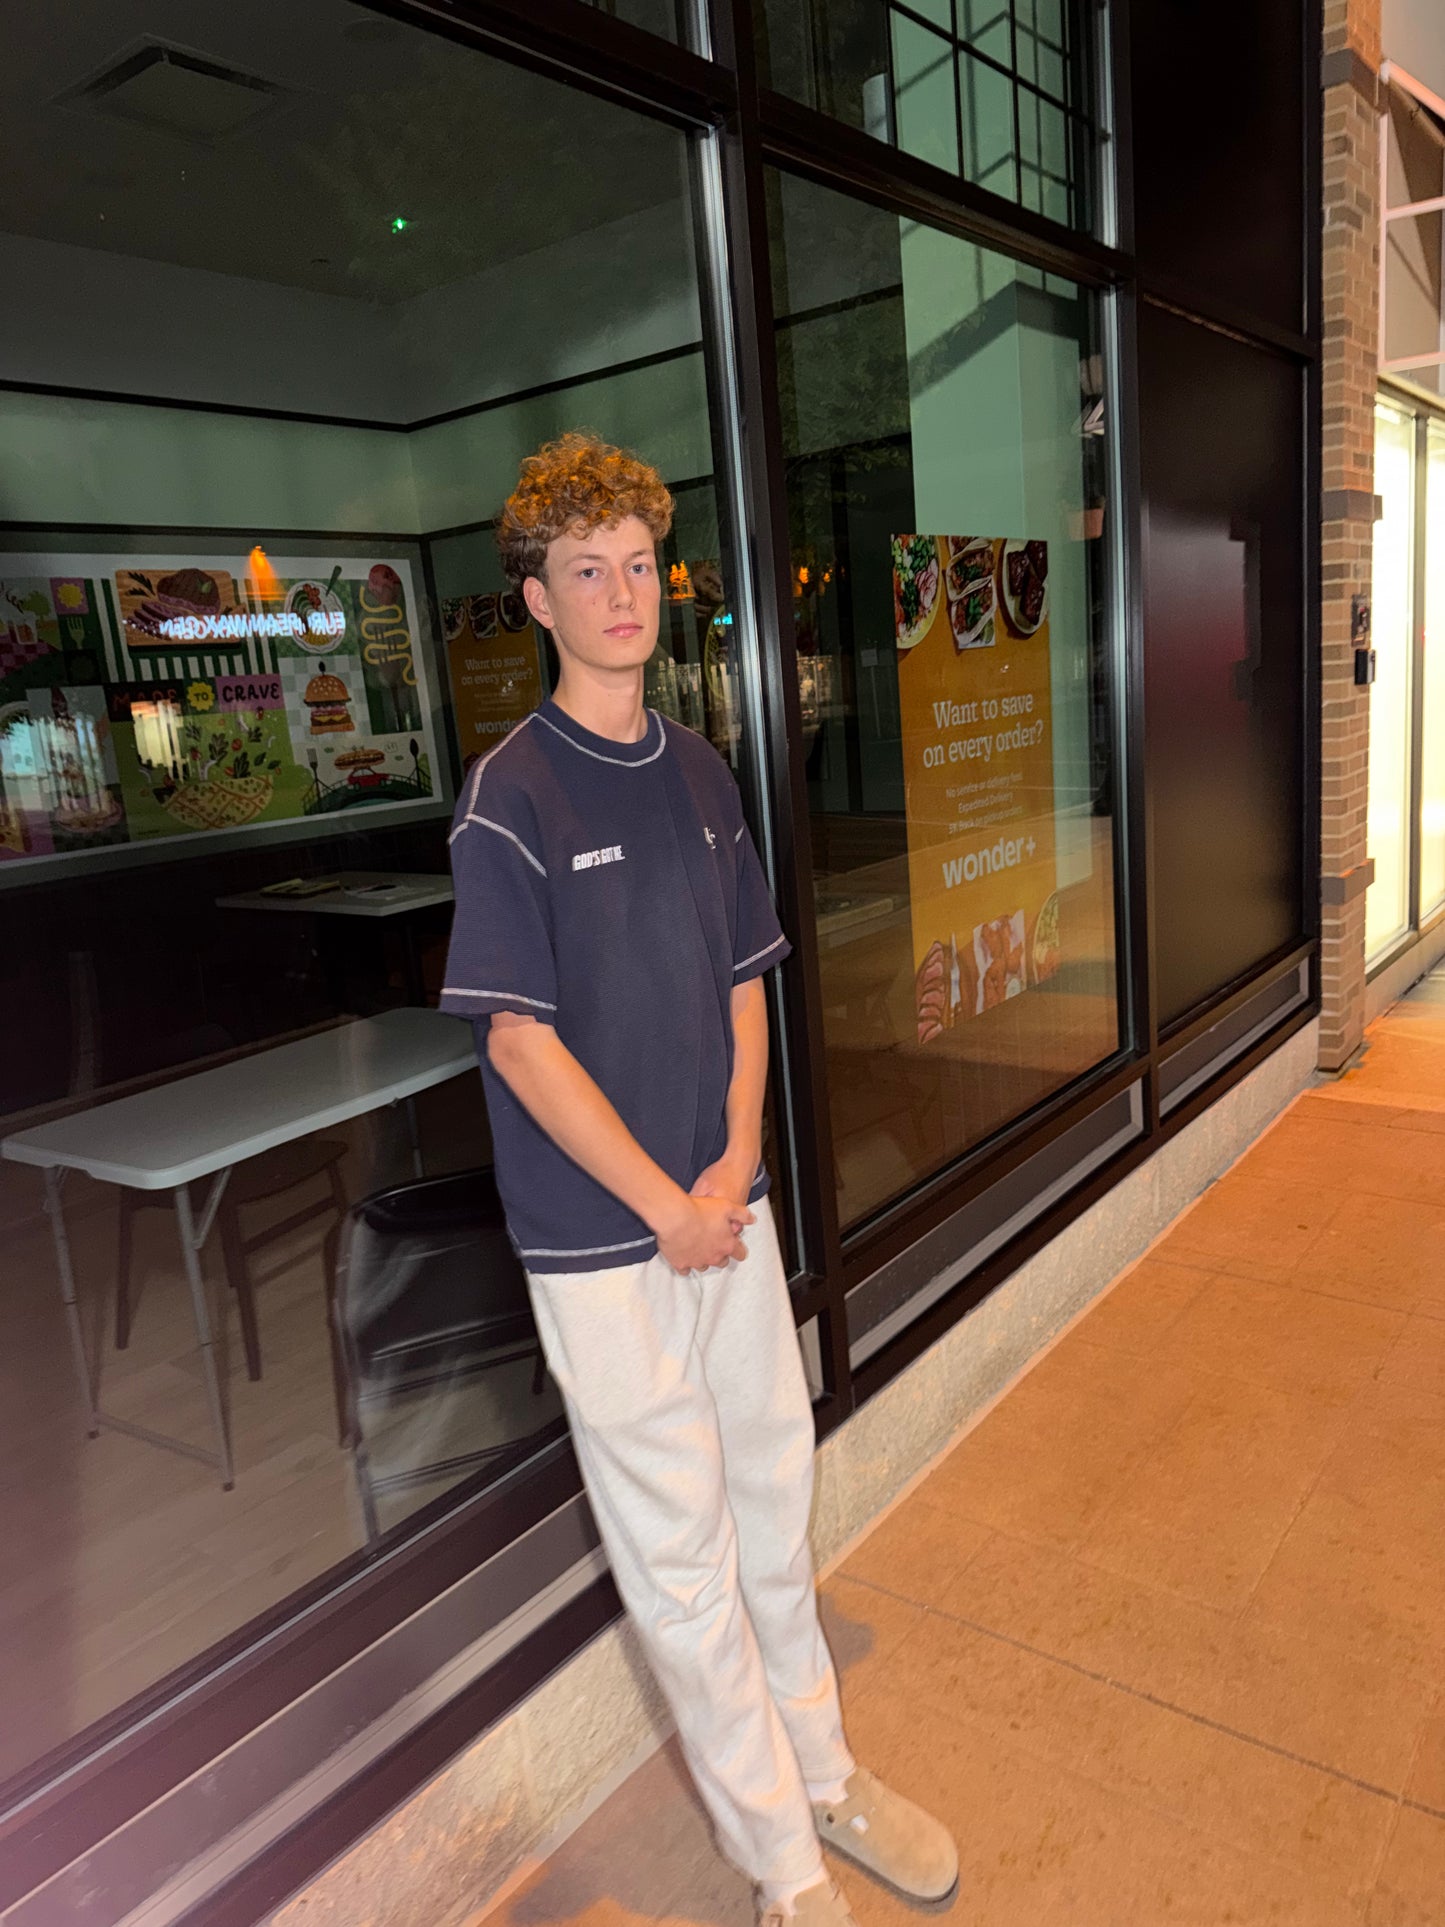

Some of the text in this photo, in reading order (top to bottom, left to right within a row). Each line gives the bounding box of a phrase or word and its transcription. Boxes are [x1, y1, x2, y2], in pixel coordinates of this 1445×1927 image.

[465, 658, 490, 671] Want
[491, 658, 503, 668] to
[461, 667, 533, 686] on every order?
[193, 691, 209, 701] TO
[222, 683, 280, 703] CRAVE
[932, 693, 1034, 729] Want to save
[474, 718, 518, 734] wond
[923, 719, 1044, 768] on every order?
[572, 850, 601, 872] GOD'S
[942, 836, 1036, 889] wonder+
